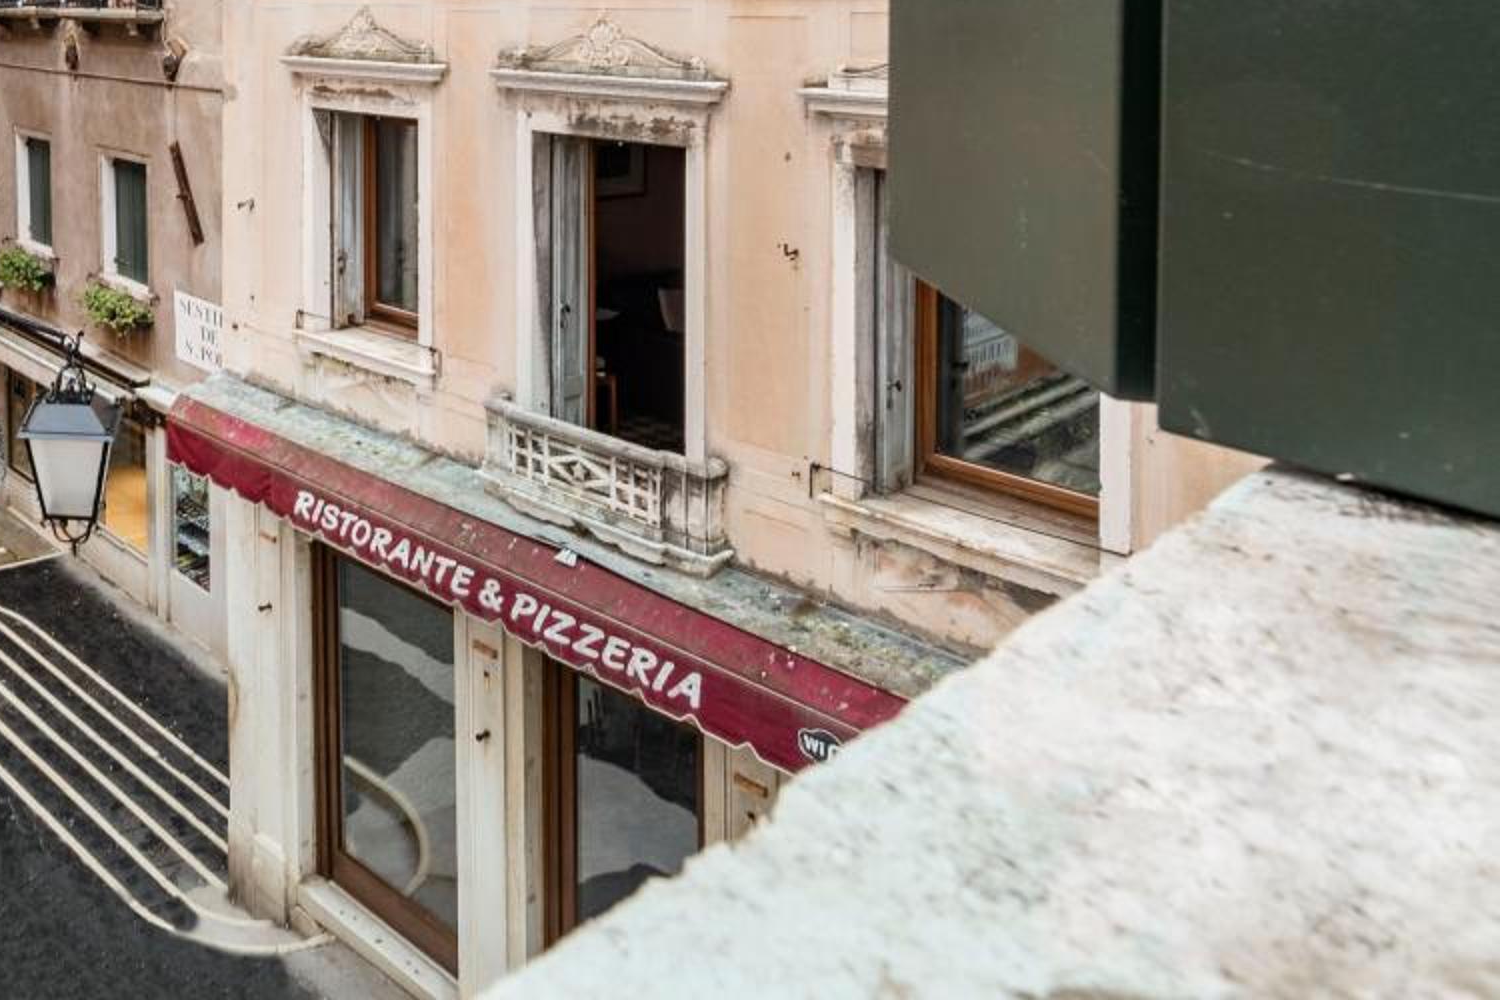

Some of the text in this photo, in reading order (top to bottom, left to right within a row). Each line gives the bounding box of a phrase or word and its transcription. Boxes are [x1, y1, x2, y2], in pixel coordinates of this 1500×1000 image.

[294, 491, 702, 709] RISTORANTE & PIZZERIA
